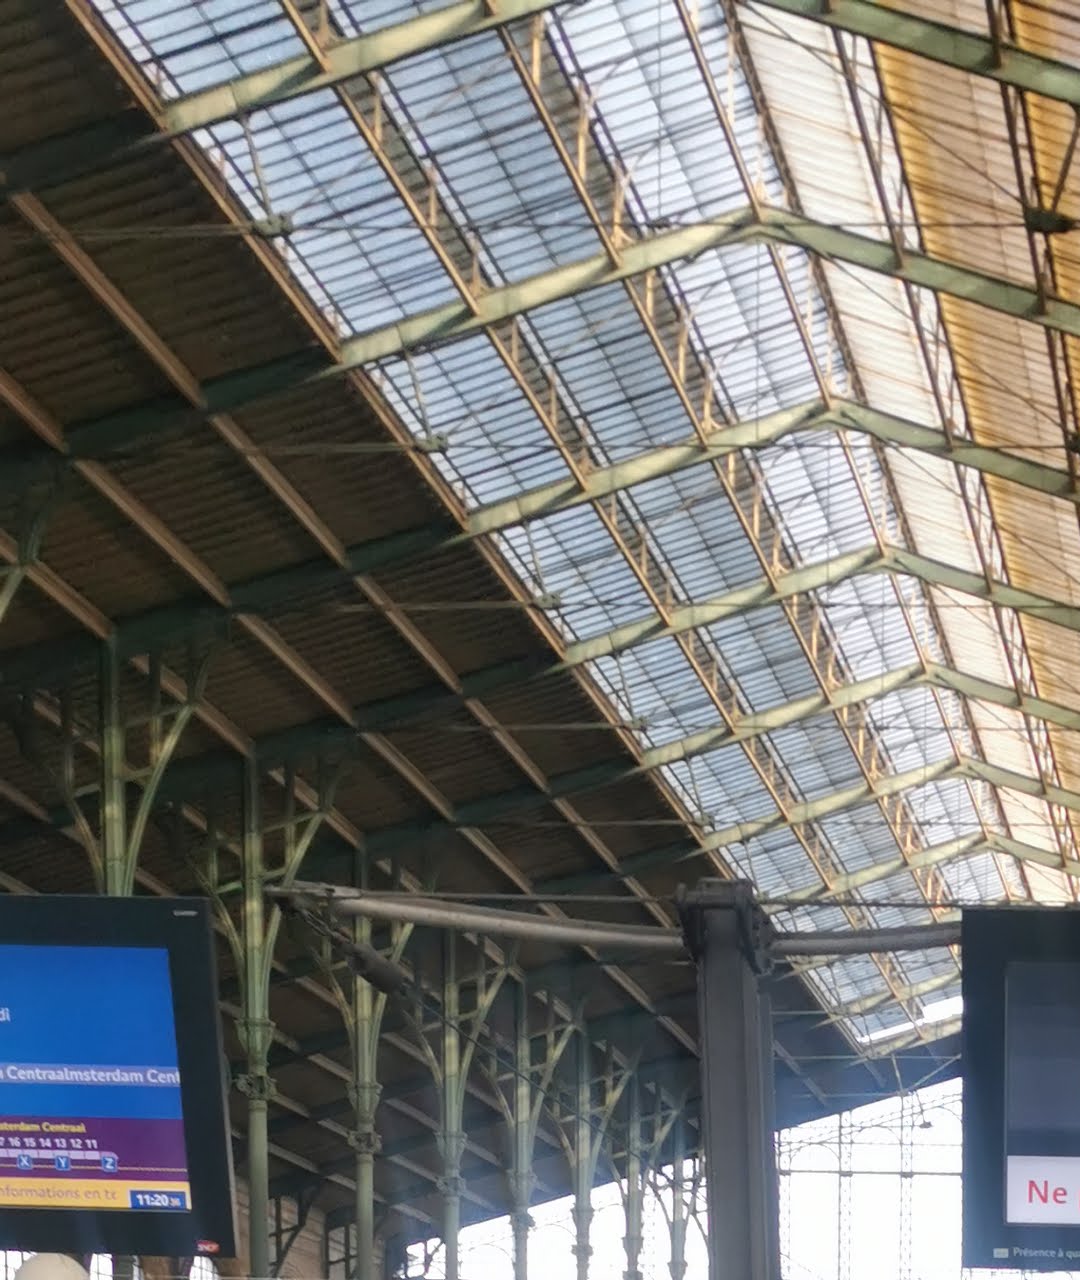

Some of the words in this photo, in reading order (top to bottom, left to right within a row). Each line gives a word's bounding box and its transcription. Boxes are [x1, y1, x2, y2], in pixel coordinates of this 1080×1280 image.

[39, 1138, 52, 1148] 14
[84, 1139, 97, 1149] 11
[1028, 1180, 1068, 1205] Ne
[136, 1193, 169, 1207] 11:20
[1013, 1246, 1055, 1258] Présence
[1057, 1247, 1065, 1258] à
